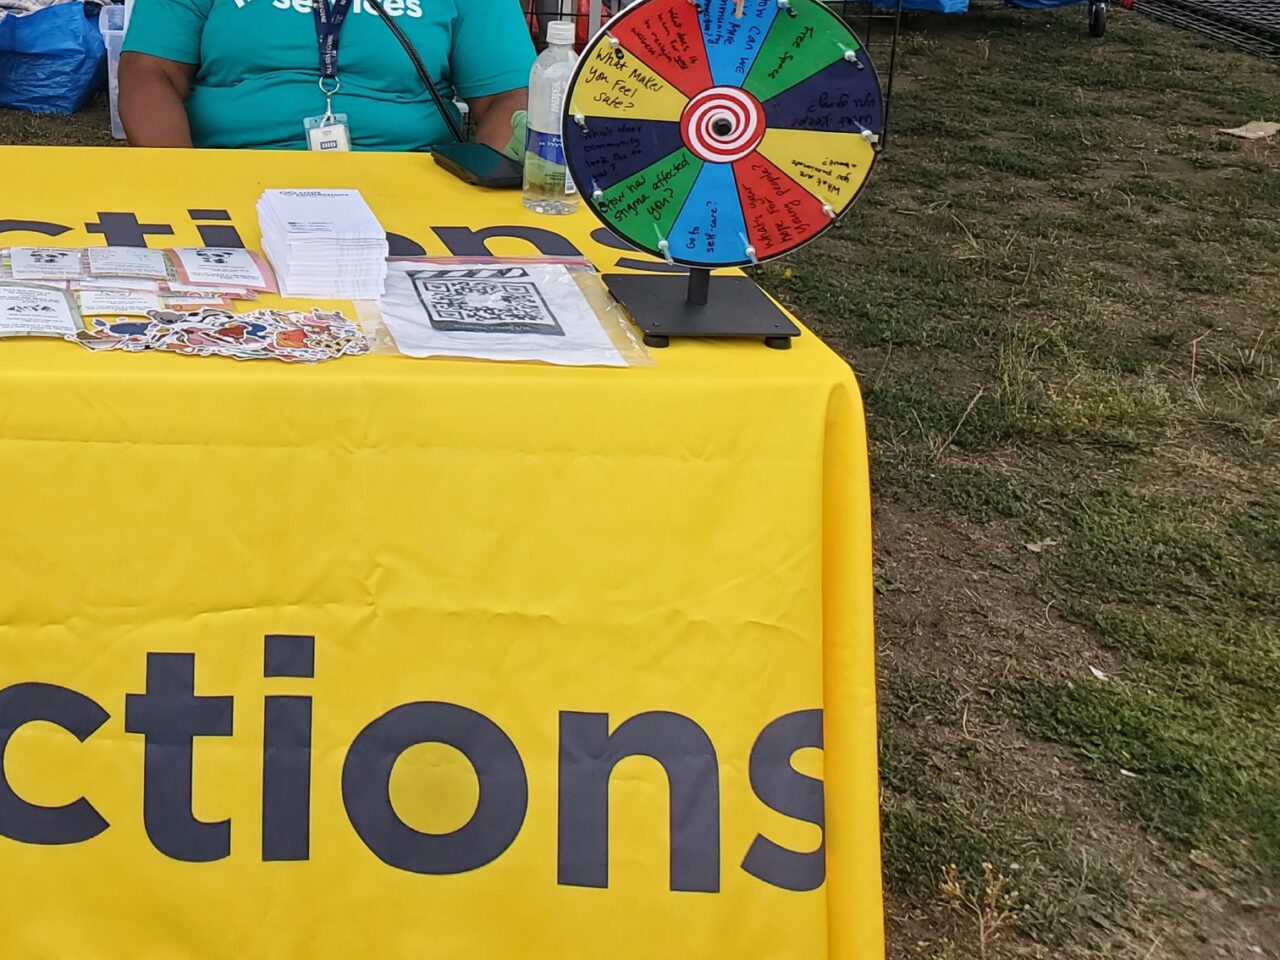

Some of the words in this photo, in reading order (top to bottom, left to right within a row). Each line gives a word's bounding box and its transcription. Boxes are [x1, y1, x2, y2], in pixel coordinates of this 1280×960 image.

[792, 26, 814, 48] Free
[596, 47, 628, 71] What
[768, 51, 794, 79] Space
[585, 66, 609, 83] you
